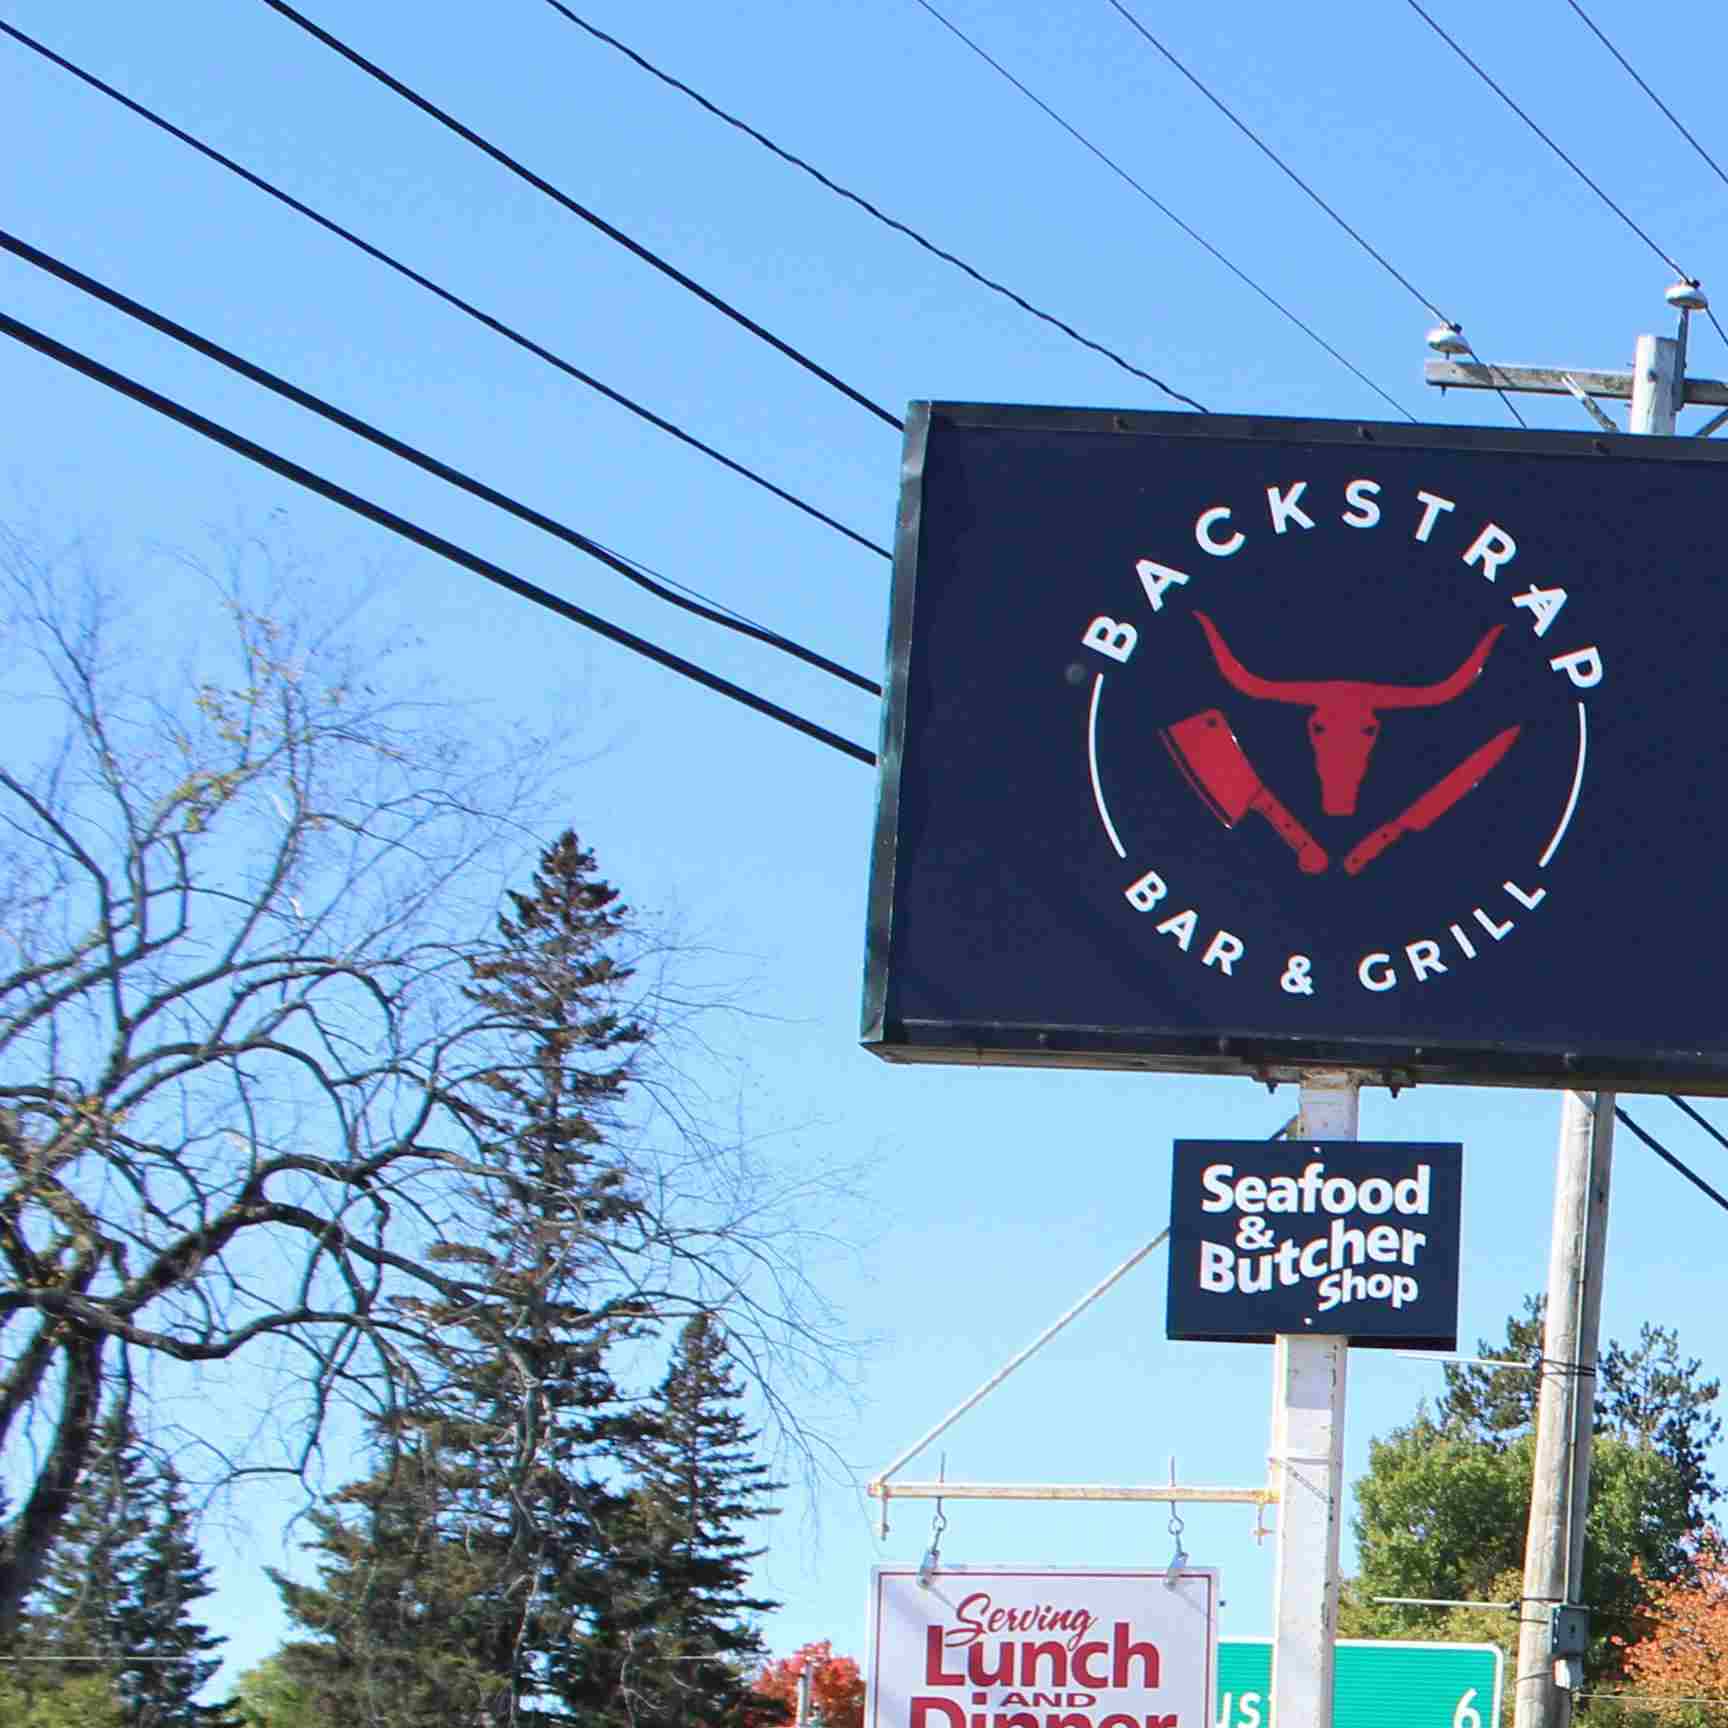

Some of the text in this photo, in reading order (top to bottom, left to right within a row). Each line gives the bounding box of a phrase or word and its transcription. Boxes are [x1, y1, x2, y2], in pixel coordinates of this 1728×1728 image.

[1082, 479, 1603, 692] BACKSTRAP
[1124, 870, 1547, 996] BAR & GRILL
[1201, 1163, 1431, 1215] Seafood
[1200, 1218, 1426, 1293] Butcher
[1235, 1215, 1275, 1250] &
[1317, 1268, 1418, 1311] Shop
[944, 1592, 1098, 1650] Serving
[925, 1622, 1160, 1689] Lunch
[1000, 1692, 1097, 1707] AND
